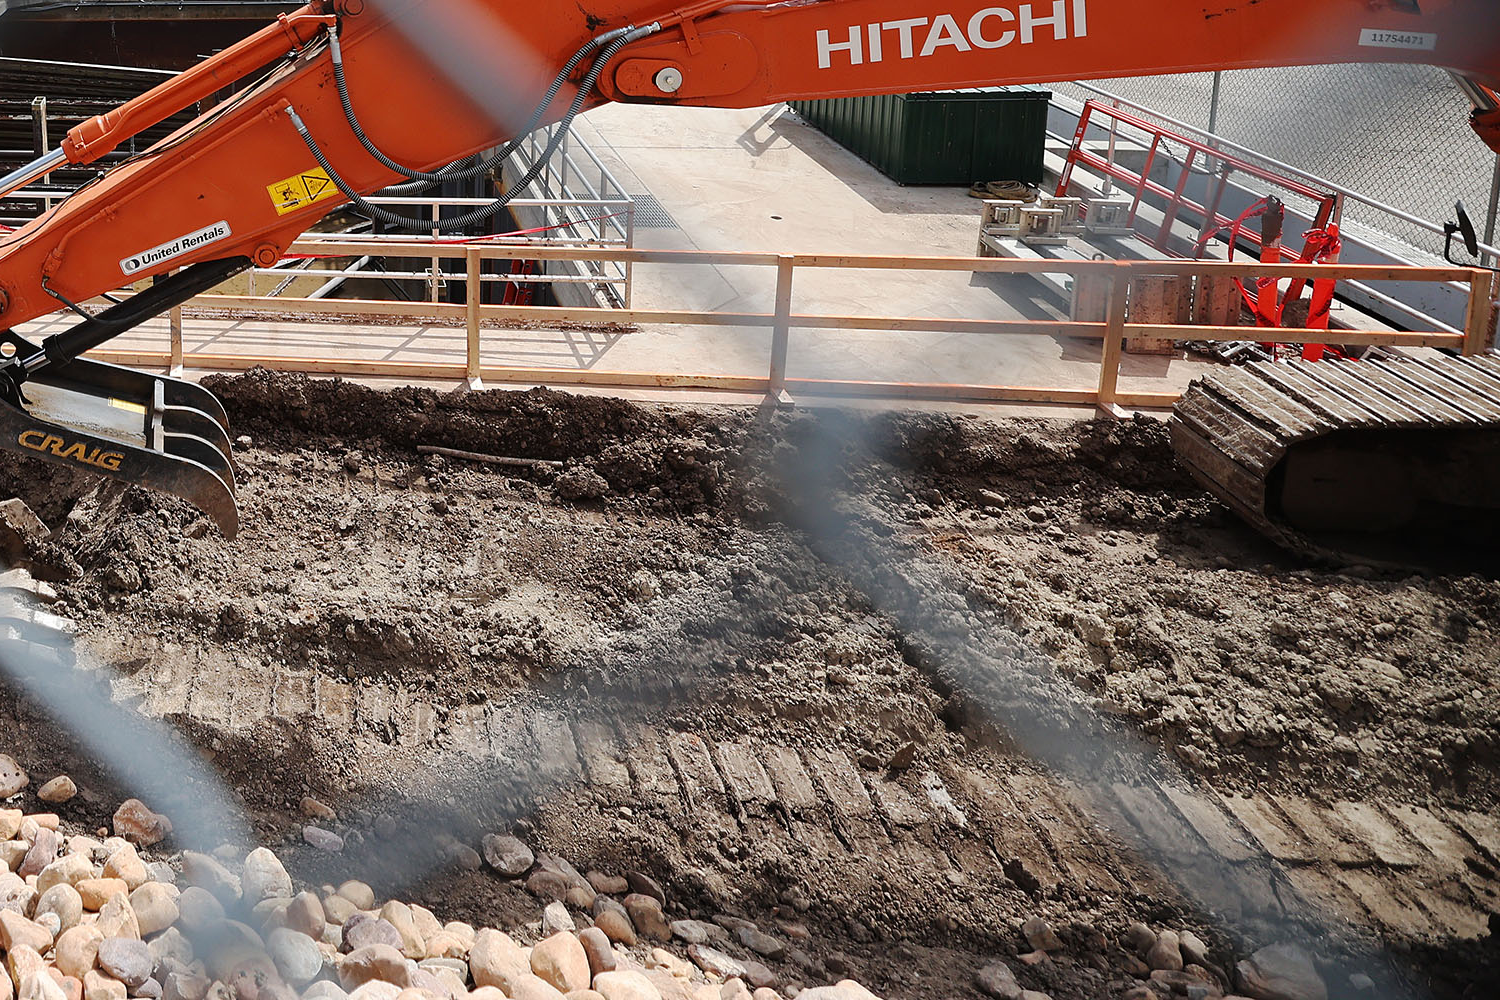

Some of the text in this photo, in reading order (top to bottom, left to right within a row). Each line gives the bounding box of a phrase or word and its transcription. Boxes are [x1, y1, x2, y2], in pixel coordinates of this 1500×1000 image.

[1371, 33, 1424, 46] 11754471
[141, 226, 224, 265] United Rentals
[18, 430, 124, 471] CRAIG
